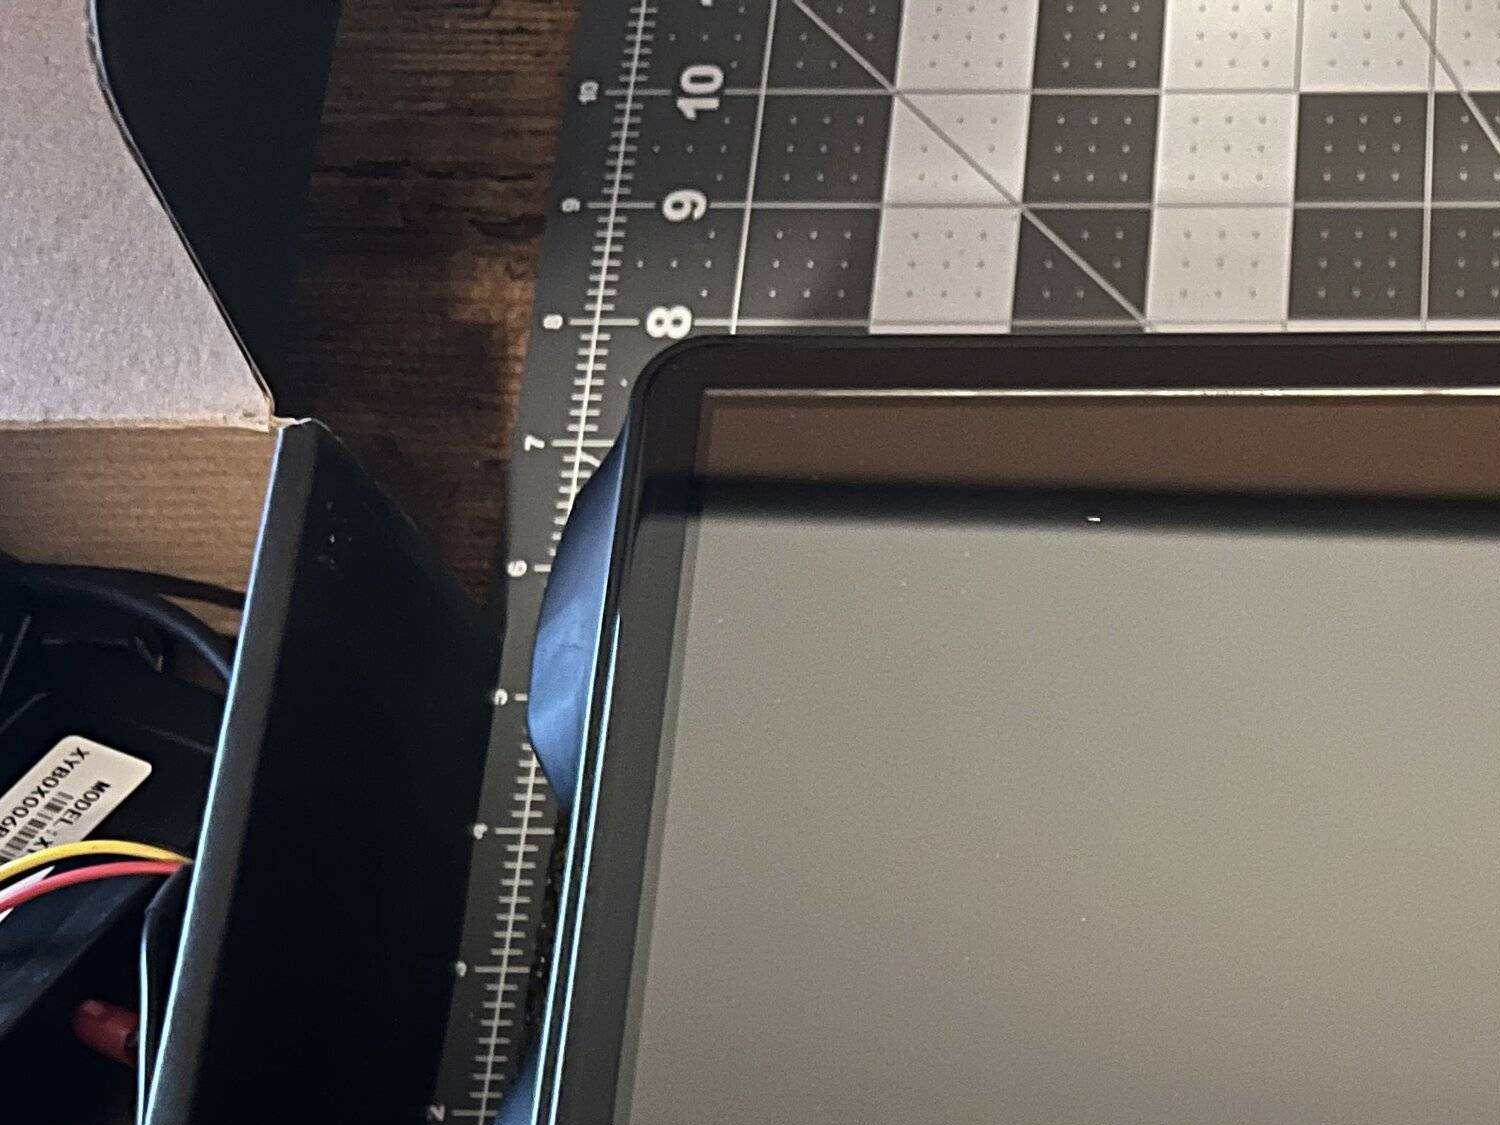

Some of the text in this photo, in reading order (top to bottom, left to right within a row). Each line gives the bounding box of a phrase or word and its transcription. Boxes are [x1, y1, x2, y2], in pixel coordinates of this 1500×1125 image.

[676, 64, 724, 120] 10
[662, 188, 707, 222] 9
[646, 304, 692, 340] 8
[524, 434, 545, 451] 7
